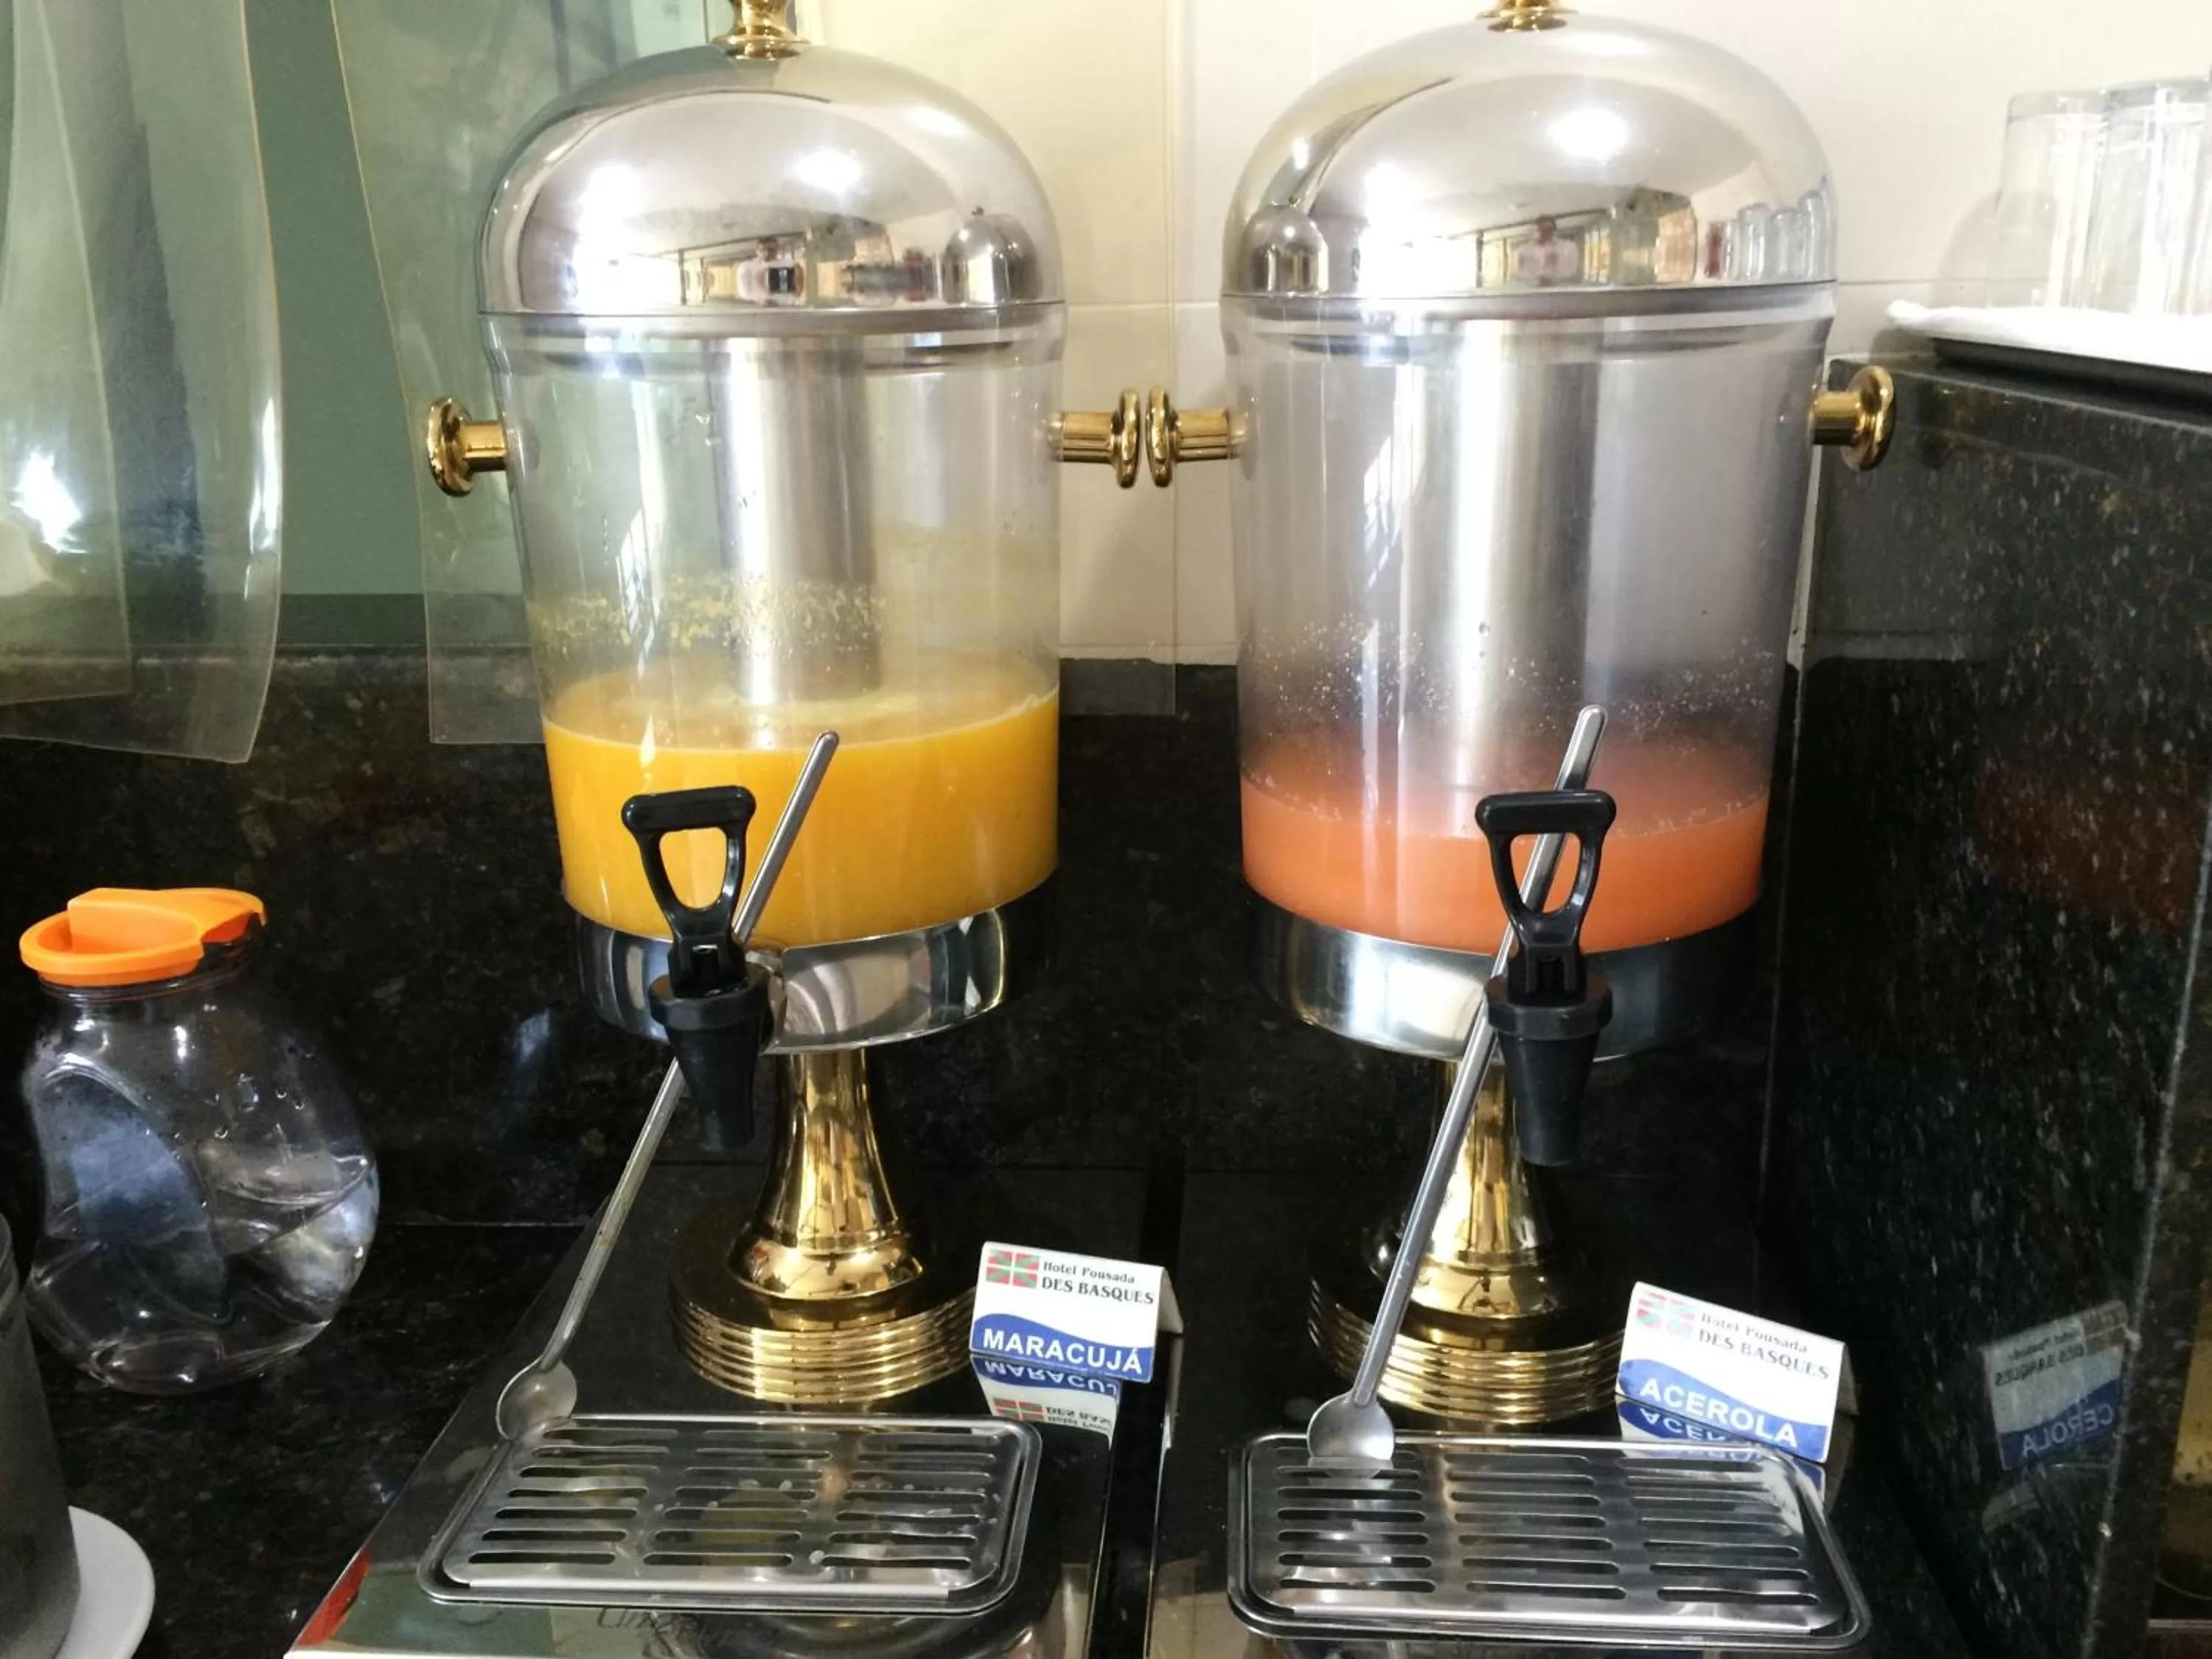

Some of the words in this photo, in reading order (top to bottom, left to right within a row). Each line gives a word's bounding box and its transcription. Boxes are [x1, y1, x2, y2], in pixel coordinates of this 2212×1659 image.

[1041, 1276, 1074, 1293] DES
[1078, 1281, 1155, 1305] BASQUES
[1043, 1262, 1077, 1276] Hotel
[1082, 1263, 1135, 1284] Pousada
[983, 1328, 1142, 1374] MARACUJÁ
[1699, 1329, 1734, 1350] DES
[1740, 1342, 1830, 1380] BASQUES
[1701, 1312, 1739, 1332] Hotel
[1745, 1326, 1809, 1354] Pousada
[1639, 1377, 1798, 1448] ACEROLA
